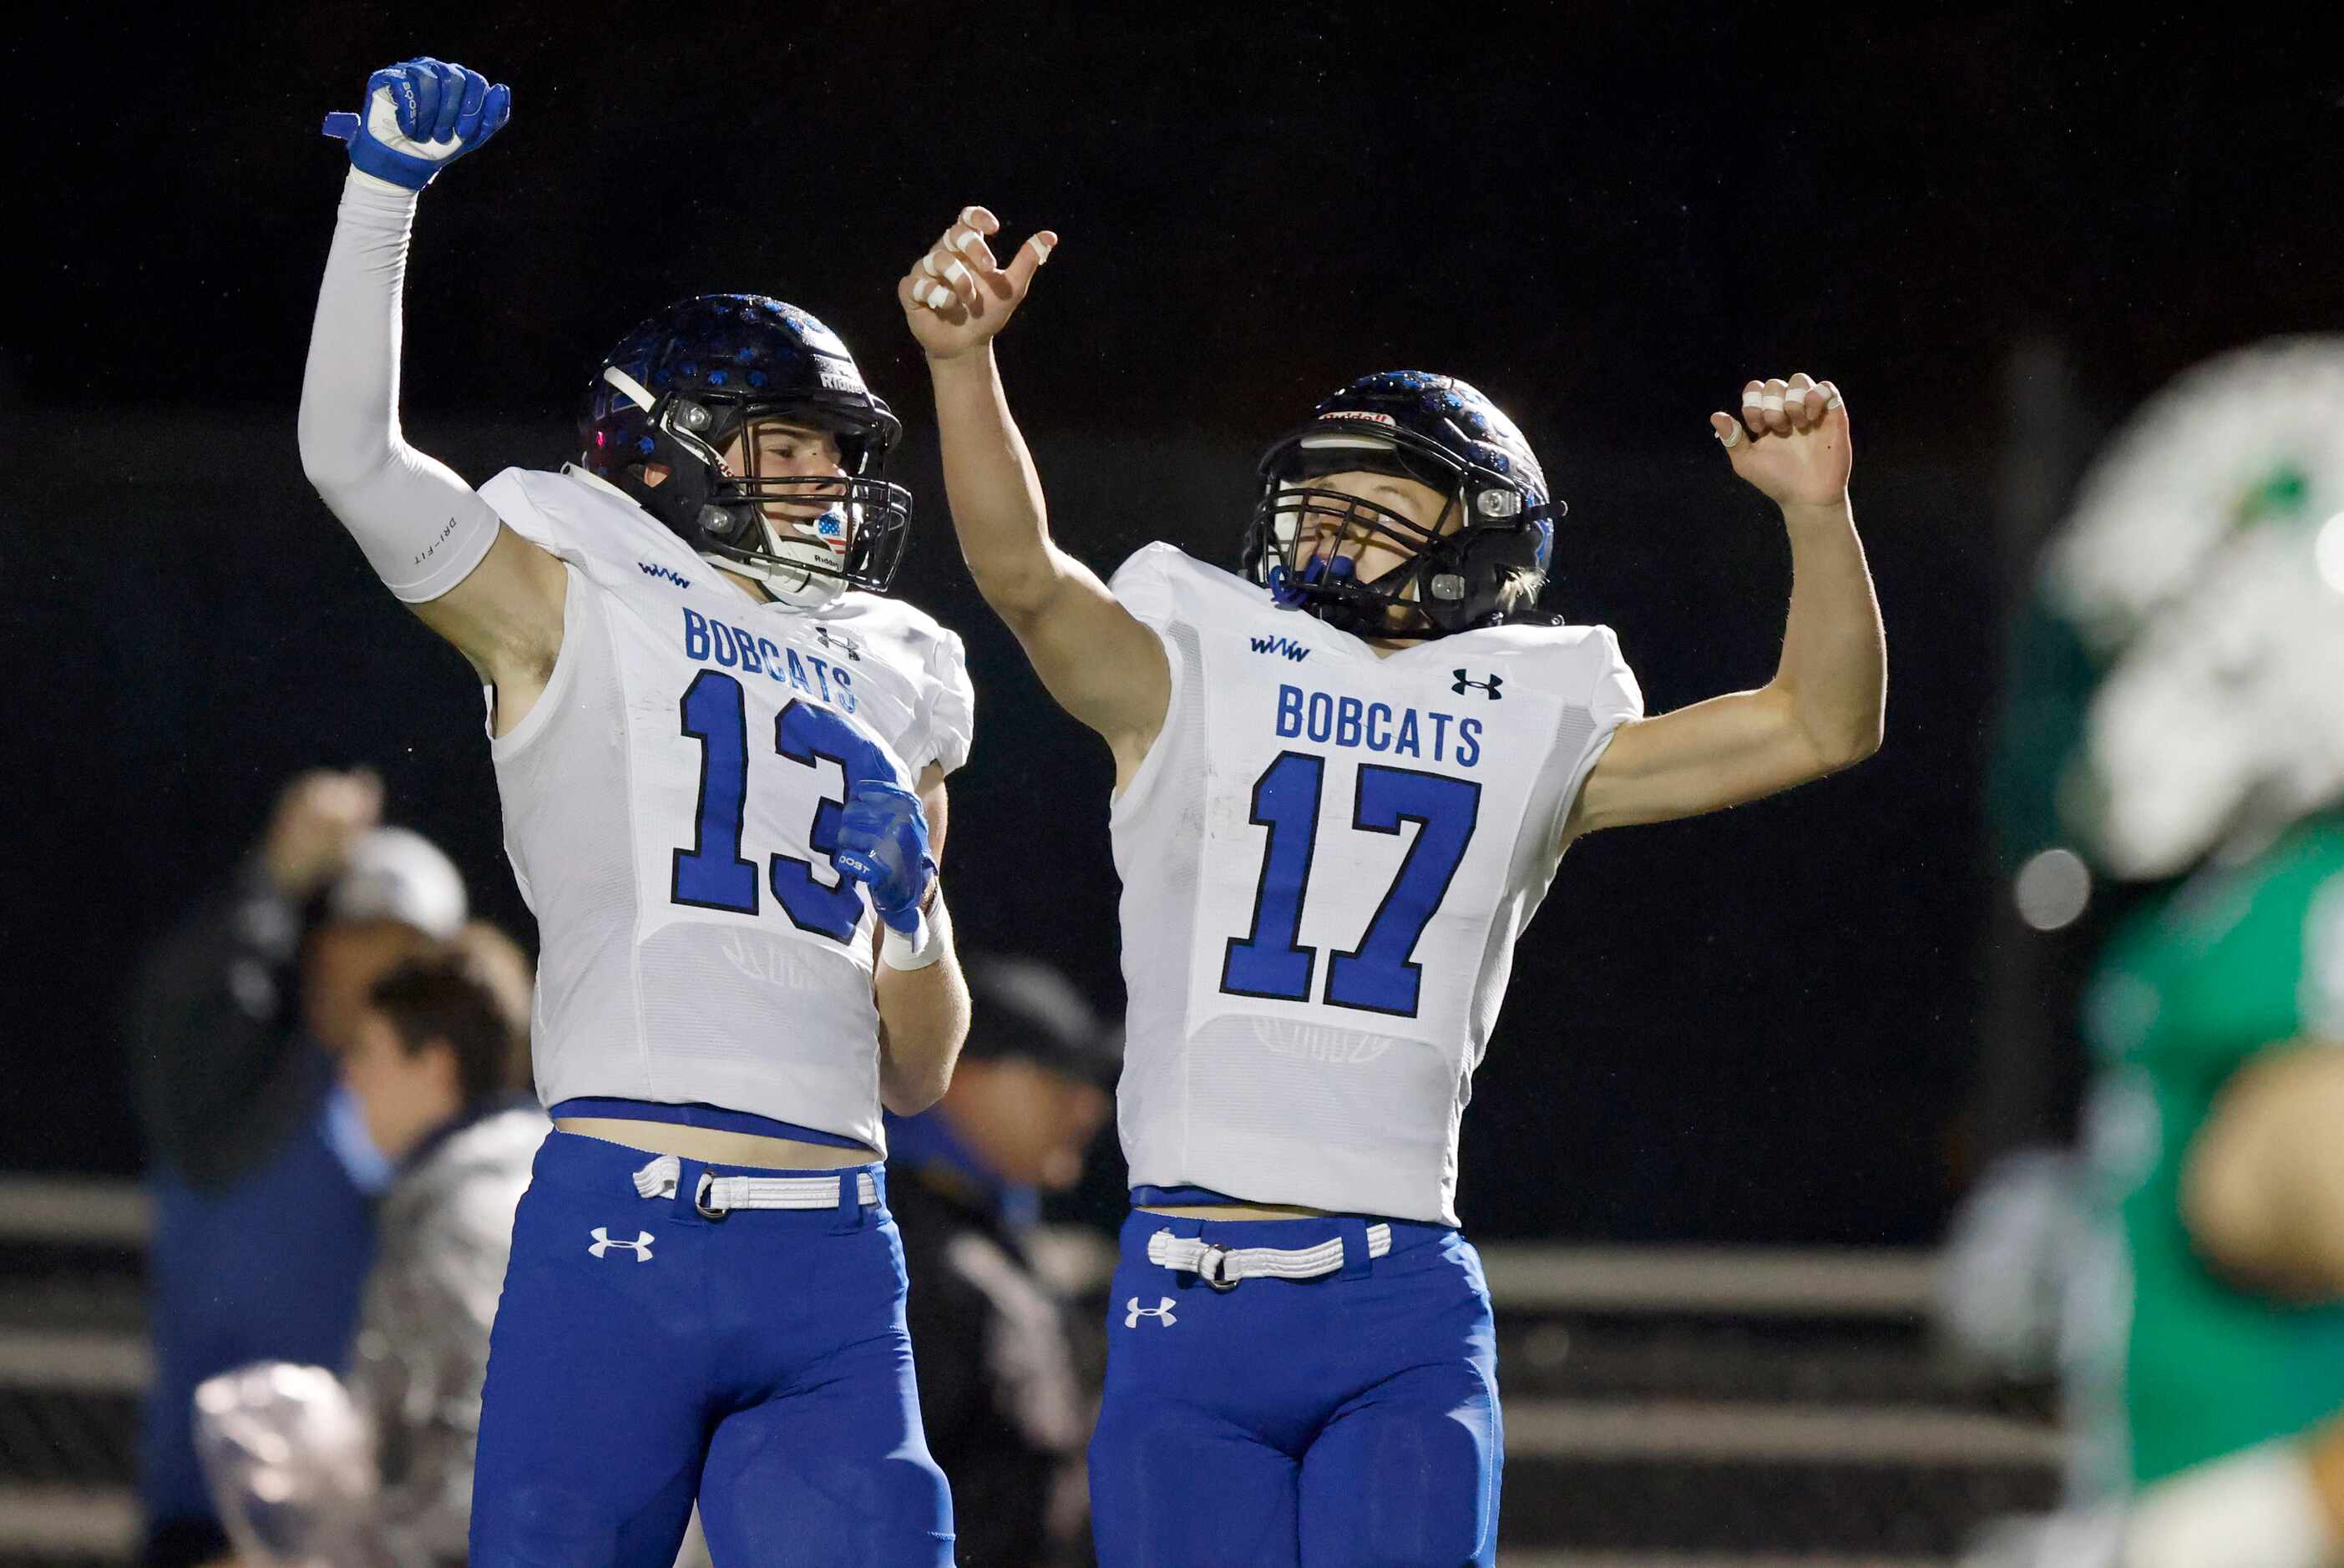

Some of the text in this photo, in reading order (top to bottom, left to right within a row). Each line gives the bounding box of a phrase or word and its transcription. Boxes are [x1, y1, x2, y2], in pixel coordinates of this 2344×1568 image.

[414, 517, 457, 564] DRI-FIT
[682, 607, 857, 713] BOBCATS
[1276, 683, 1483, 767] BOBCATS
[671, 668, 899, 946] 13
[1219, 750, 1482, 1019] 17
